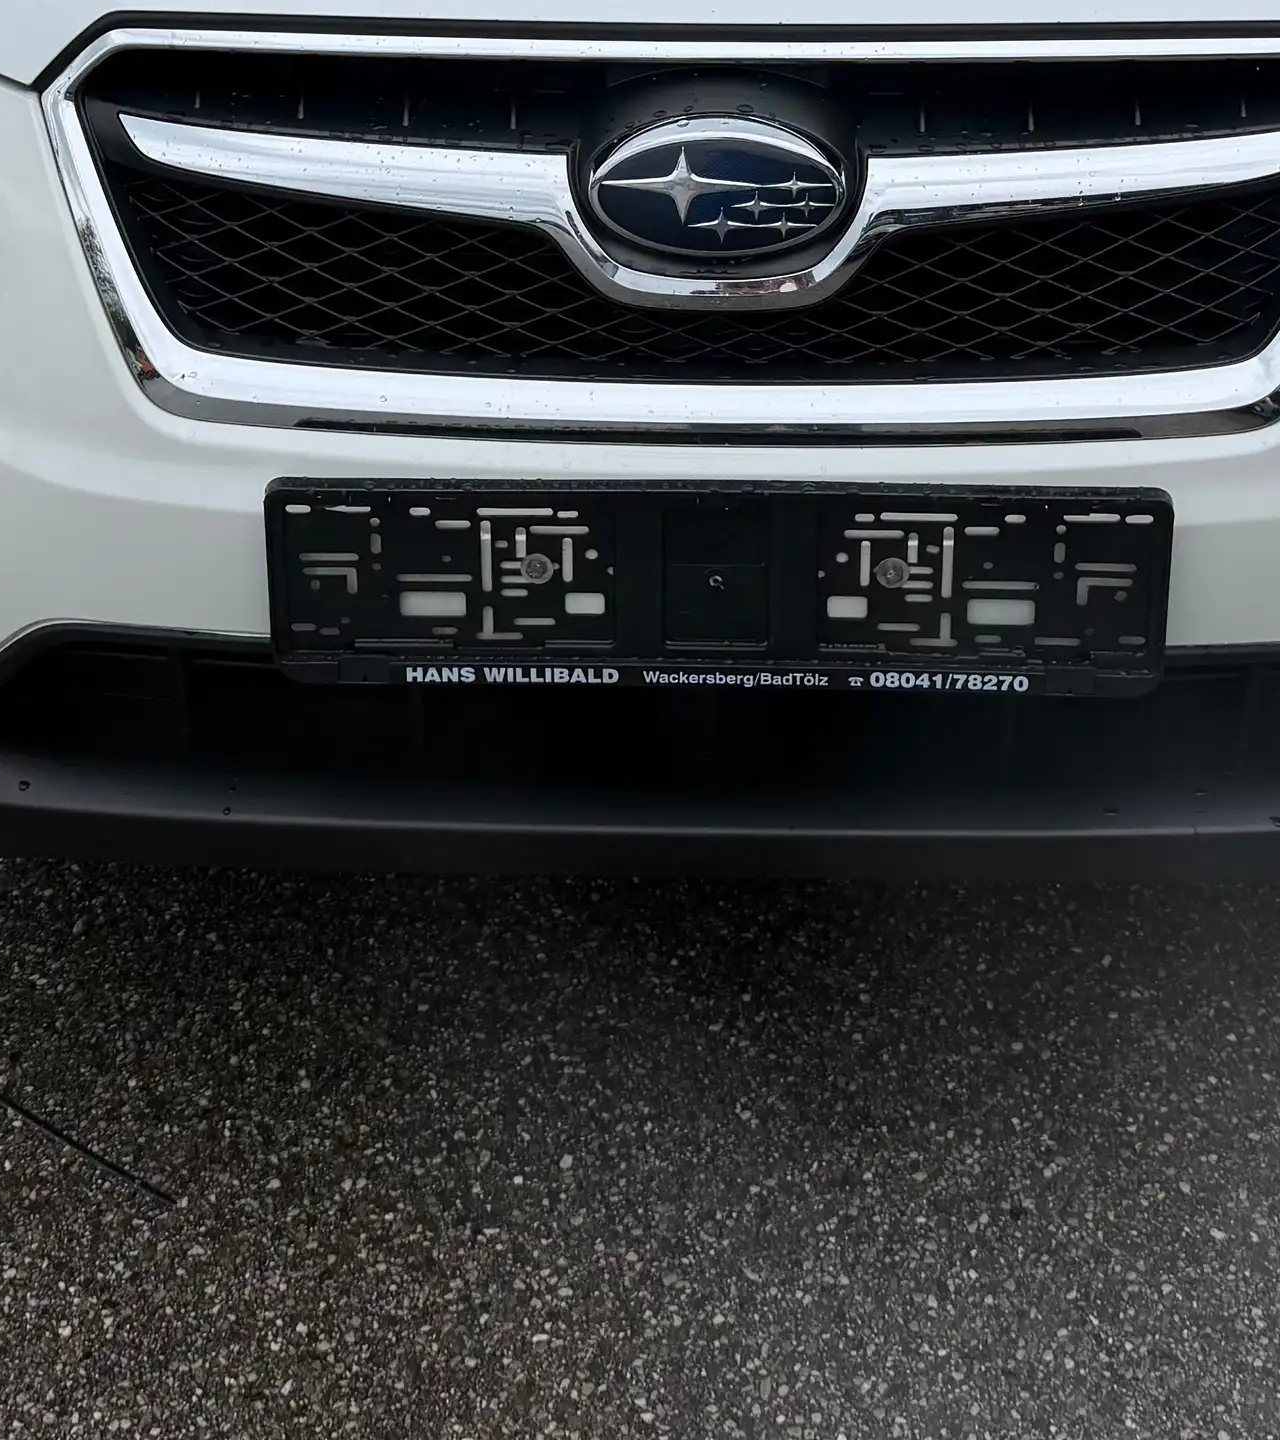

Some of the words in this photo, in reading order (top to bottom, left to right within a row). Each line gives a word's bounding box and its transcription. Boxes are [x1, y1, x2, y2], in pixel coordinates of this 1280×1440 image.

[405, 666, 476, 683] HANS
[483, 667, 620, 684] WILLIBALD
[642, 670, 829, 688] Wackersberg/BadTölz
[869, 671, 1030, 692] 08041/78270
